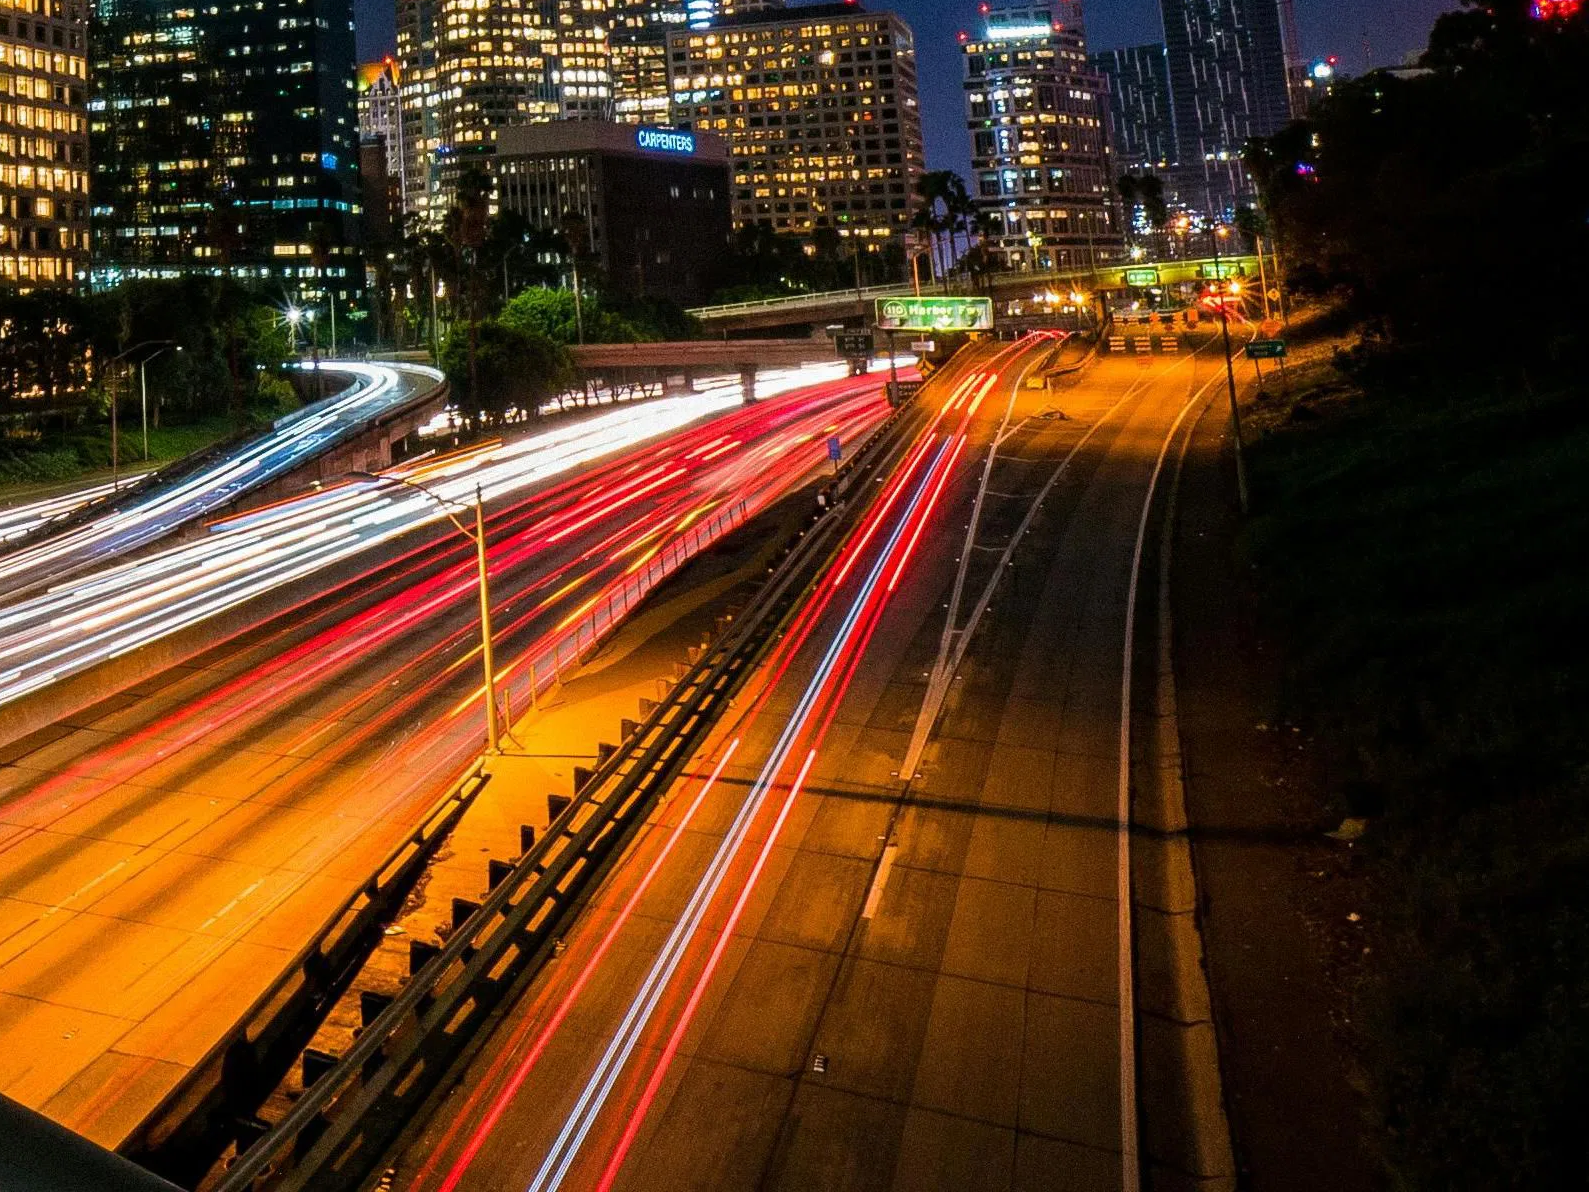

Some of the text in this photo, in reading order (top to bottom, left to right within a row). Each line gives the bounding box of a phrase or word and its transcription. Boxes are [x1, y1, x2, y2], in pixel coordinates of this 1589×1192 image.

[638, 130, 693, 151] CARPENTERS
[886, 306, 903, 315] 110
[909, 305, 953, 316] Harbor
